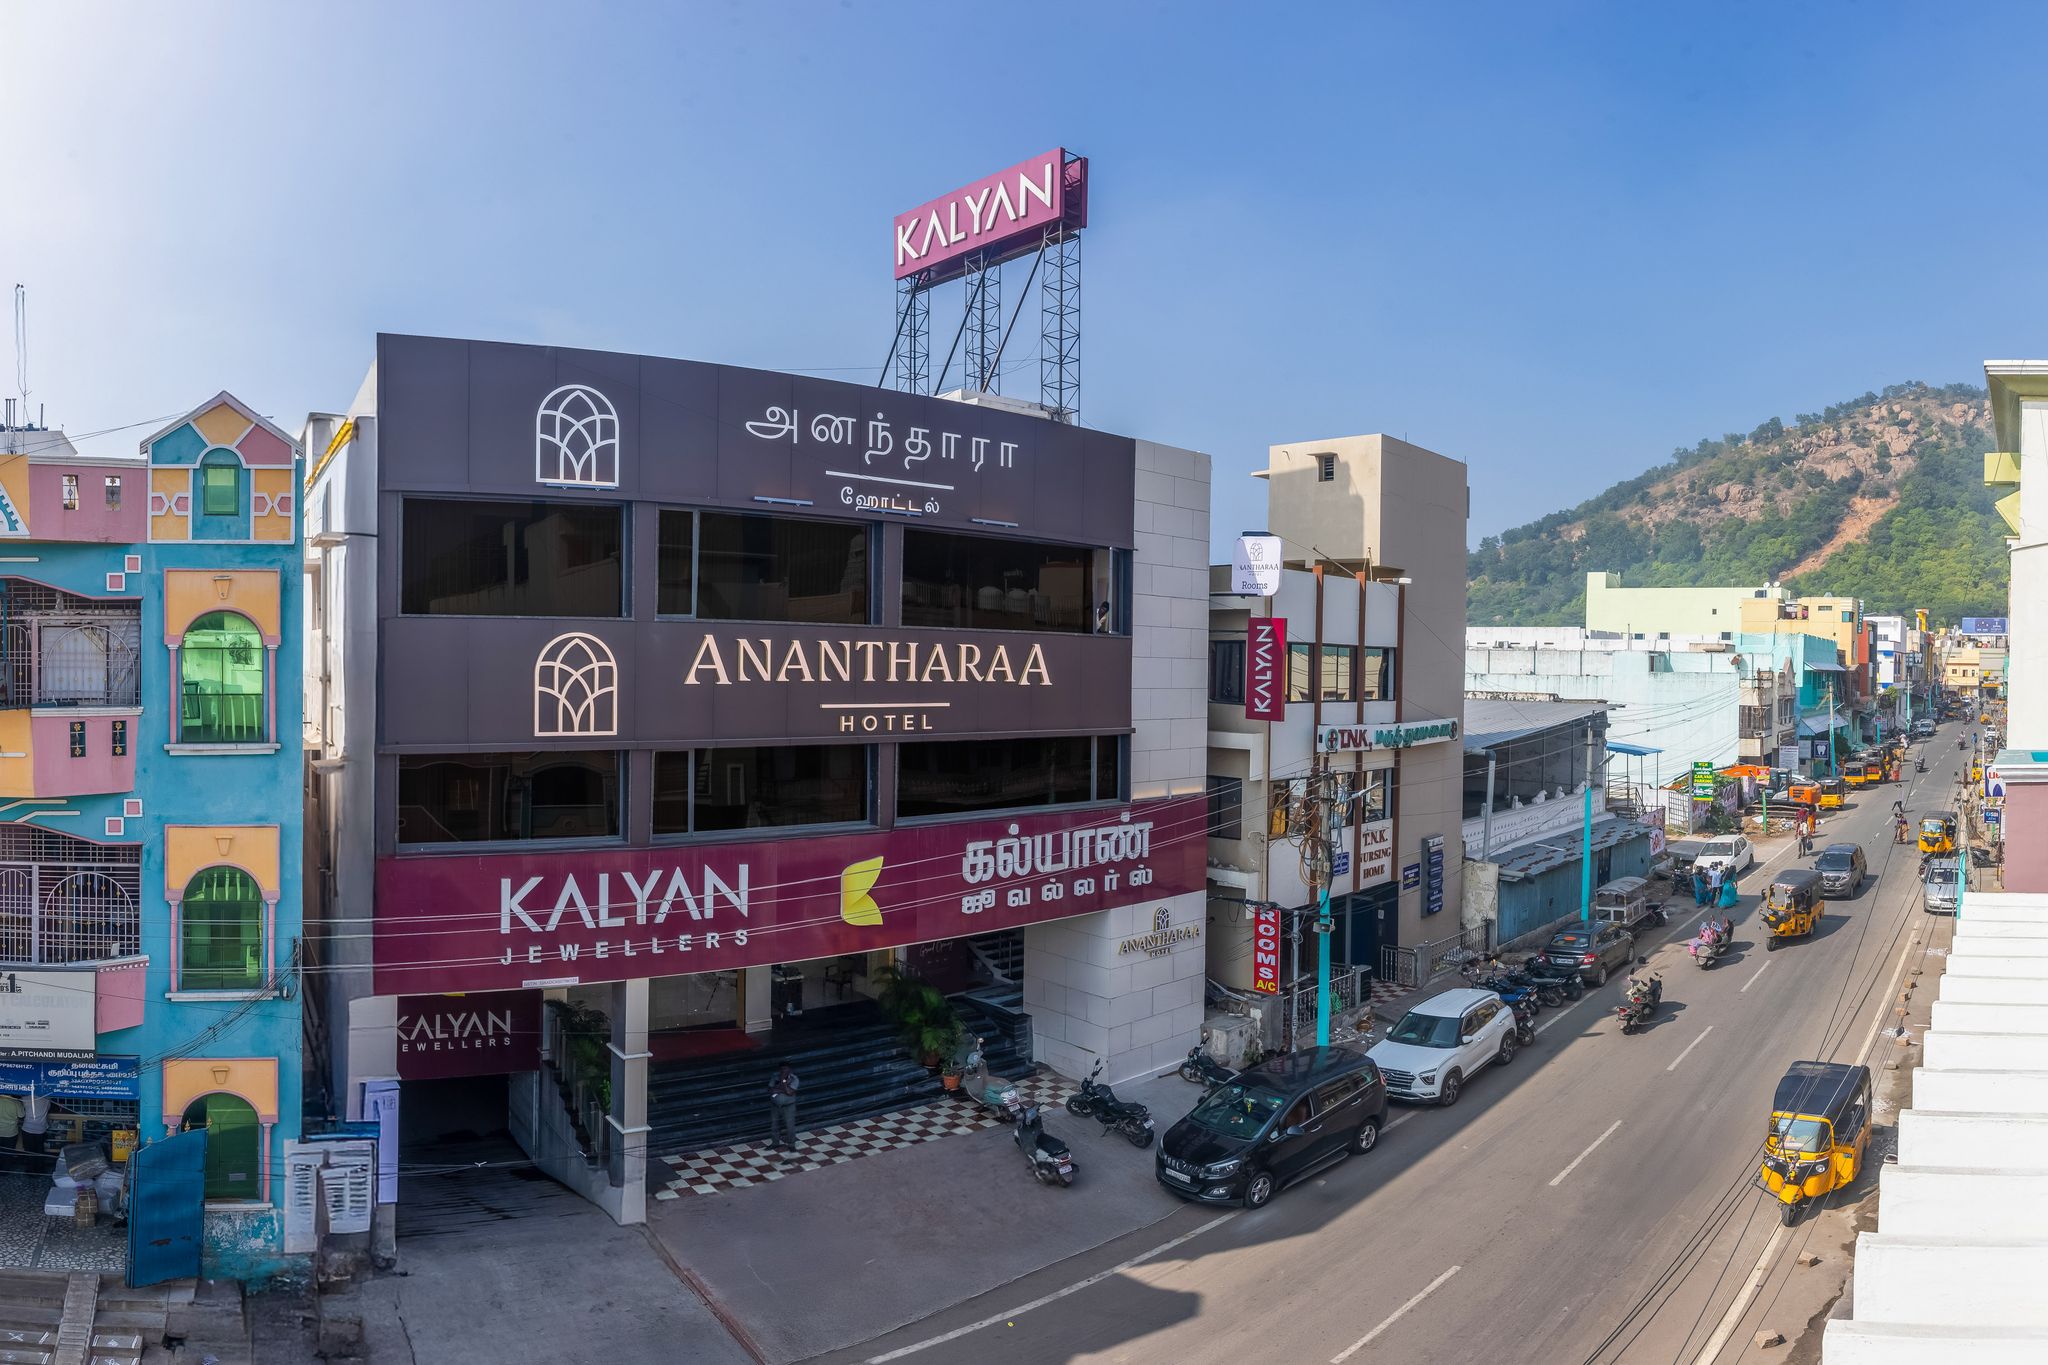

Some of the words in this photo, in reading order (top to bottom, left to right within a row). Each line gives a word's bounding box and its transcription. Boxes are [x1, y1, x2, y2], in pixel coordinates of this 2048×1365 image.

[898, 162, 1054, 266] KALYAN
[745, 406, 1019, 473] அனந்தாரா
[840, 486, 940, 514] ஹோட்டல்
[1241, 580, 1268, 590] Rooms
[683, 634, 1053, 687] ANANTHARAA
[1254, 625, 1273, 713] KALYAN
[839, 713, 934, 733] HOTEL
[962, 811, 1154, 884] கல்யாண்
[1363, 864, 1385, 880] HOME
[500, 863, 749, 934] KALYAN
[500, 929, 749, 965] JEWELLERS
[1119, 926, 1200, 955] ANANTHARAA
[1257, 908, 1277, 979] ROOMS
[1256, 980, 1276, 991] A/C
[397, 1009, 512, 1041] KALYAN
[11, 1050, 57, 1058] A.PITCHANDI
[56, 1052, 94, 1060] MUDALIAR
[402, 1037, 511, 1052] EWELLERS
